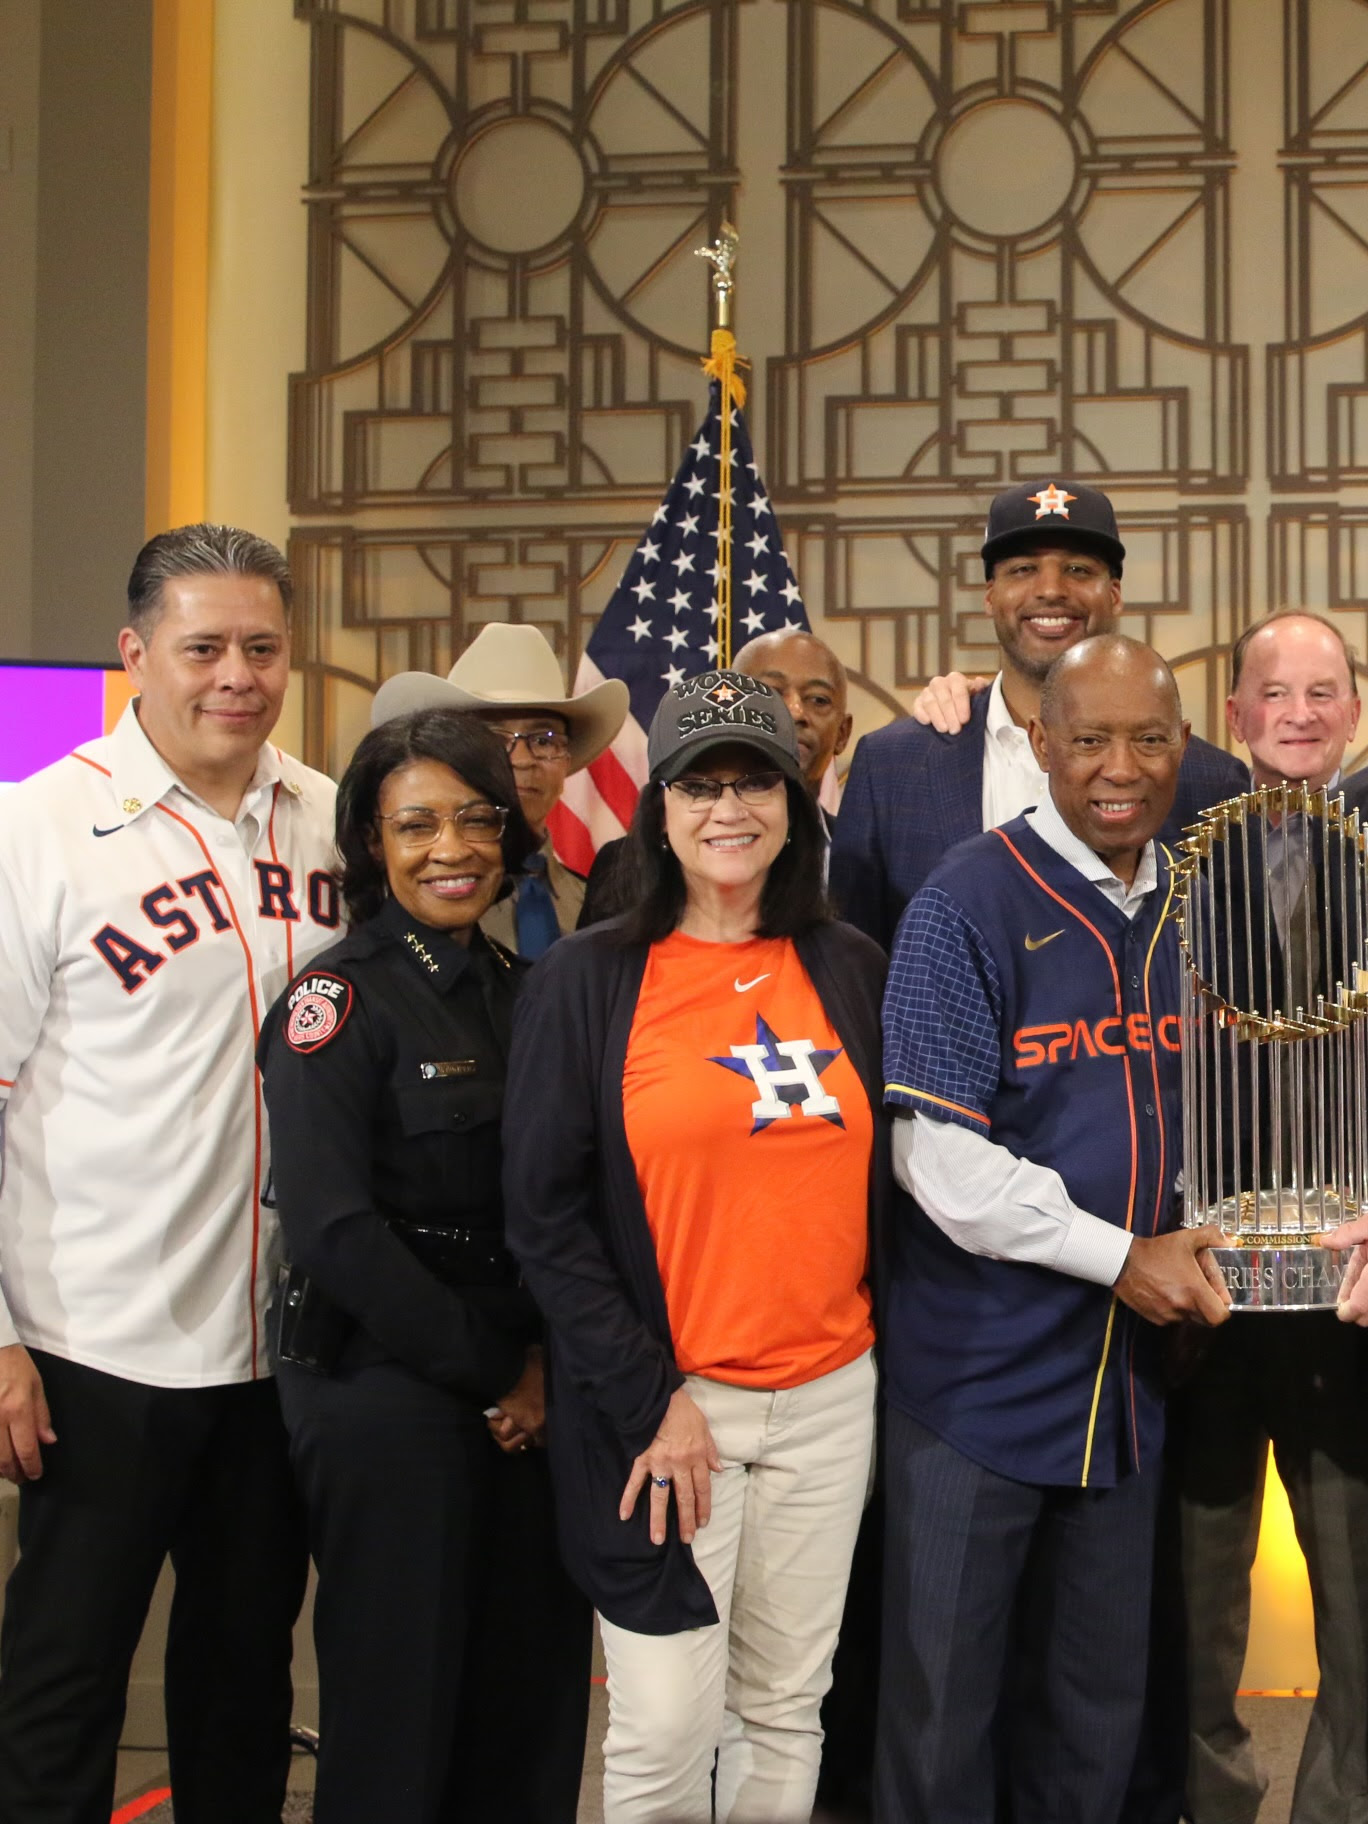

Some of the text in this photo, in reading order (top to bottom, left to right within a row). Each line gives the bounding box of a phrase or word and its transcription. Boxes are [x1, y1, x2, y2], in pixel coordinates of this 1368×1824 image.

[673, 671, 773, 700] WORLD
[677, 706, 777, 739] SERIES
[90, 857, 341, 996] ASTRO
[288, 978, 344, 1010] POLICE
[1013, 1013, 1152, 1069] SPACE
[729, 1039, 841, 1119] H
